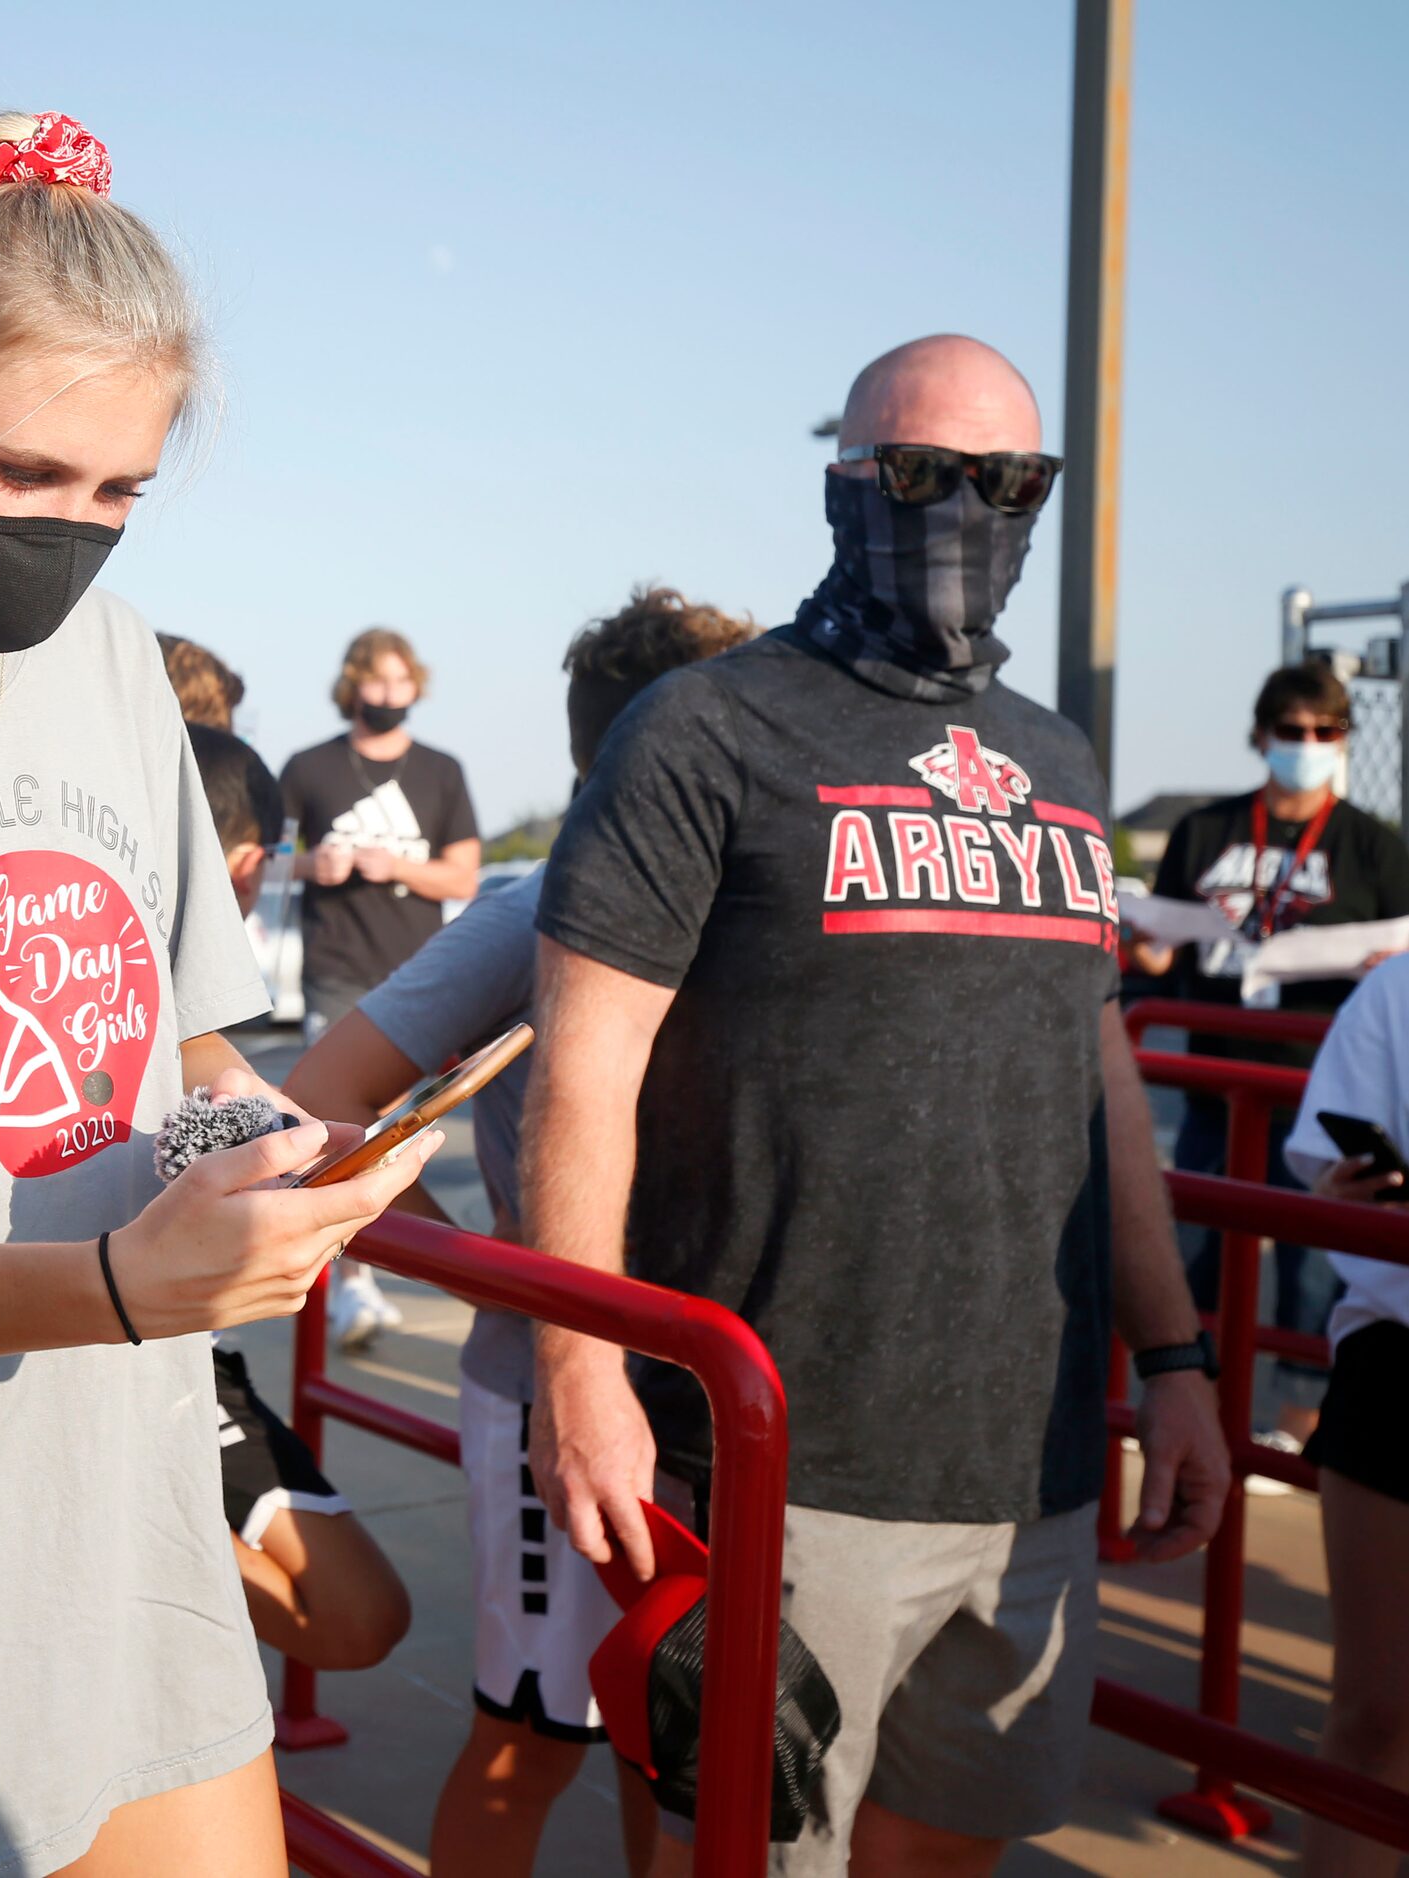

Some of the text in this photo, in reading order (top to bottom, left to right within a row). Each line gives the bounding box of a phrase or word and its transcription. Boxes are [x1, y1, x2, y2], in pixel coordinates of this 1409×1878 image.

[61, 780, 139, 875] HIGH
[823, 809, 1120, 925] ARGYLE
[20, 933, 122, 1005] Day
[62, 988, 148, 1072] Girls
[56, 1111, 115, 1158] 2020
